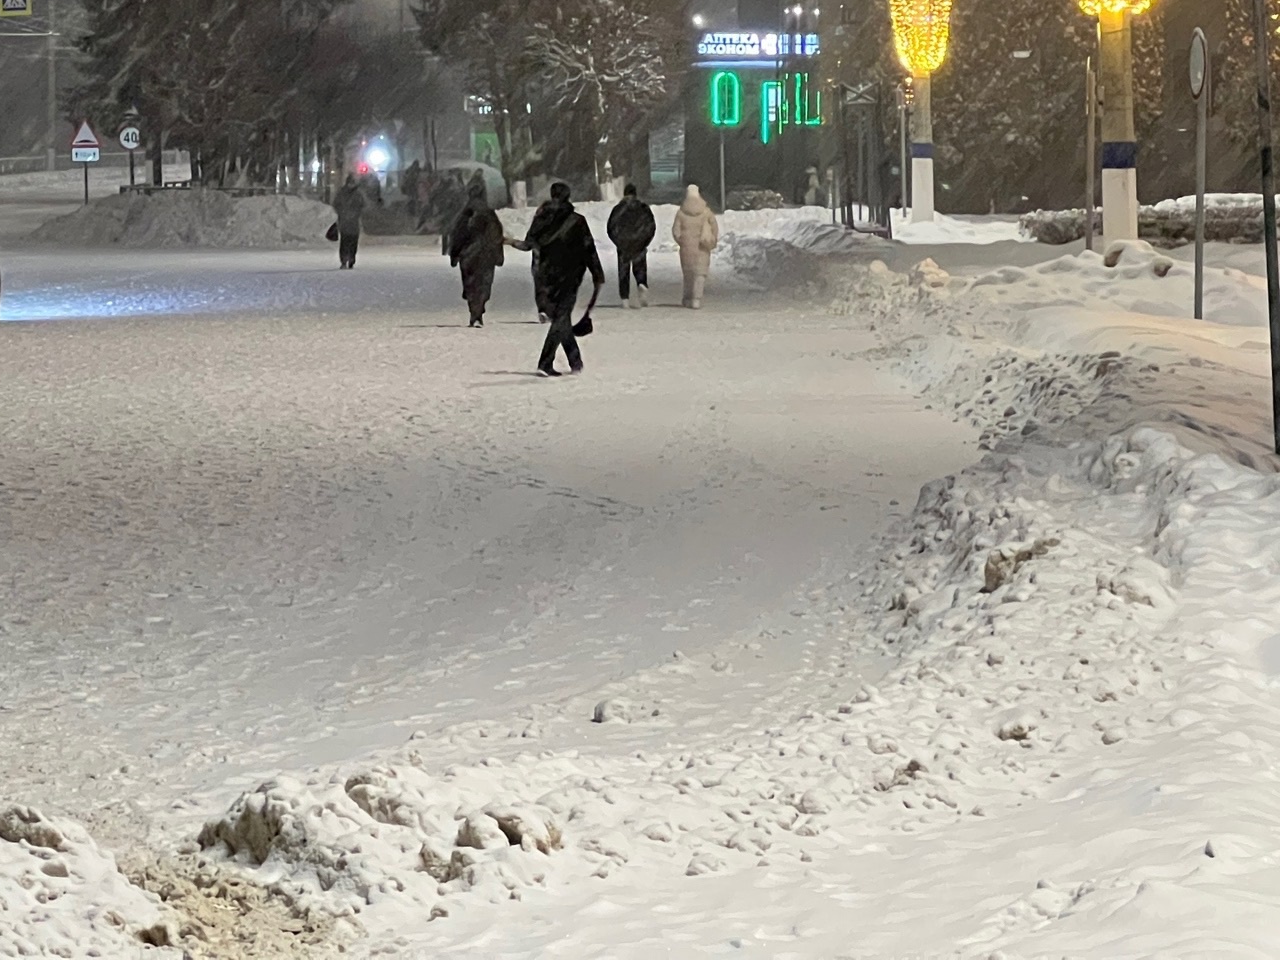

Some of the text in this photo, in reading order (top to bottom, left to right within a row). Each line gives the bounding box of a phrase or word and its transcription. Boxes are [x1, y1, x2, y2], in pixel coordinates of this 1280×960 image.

[704, 33, 759, 43] АПТЕКА
[698, 43, 760, 55] ЭКОНОМ
[123, 131, 138, 143] 40
